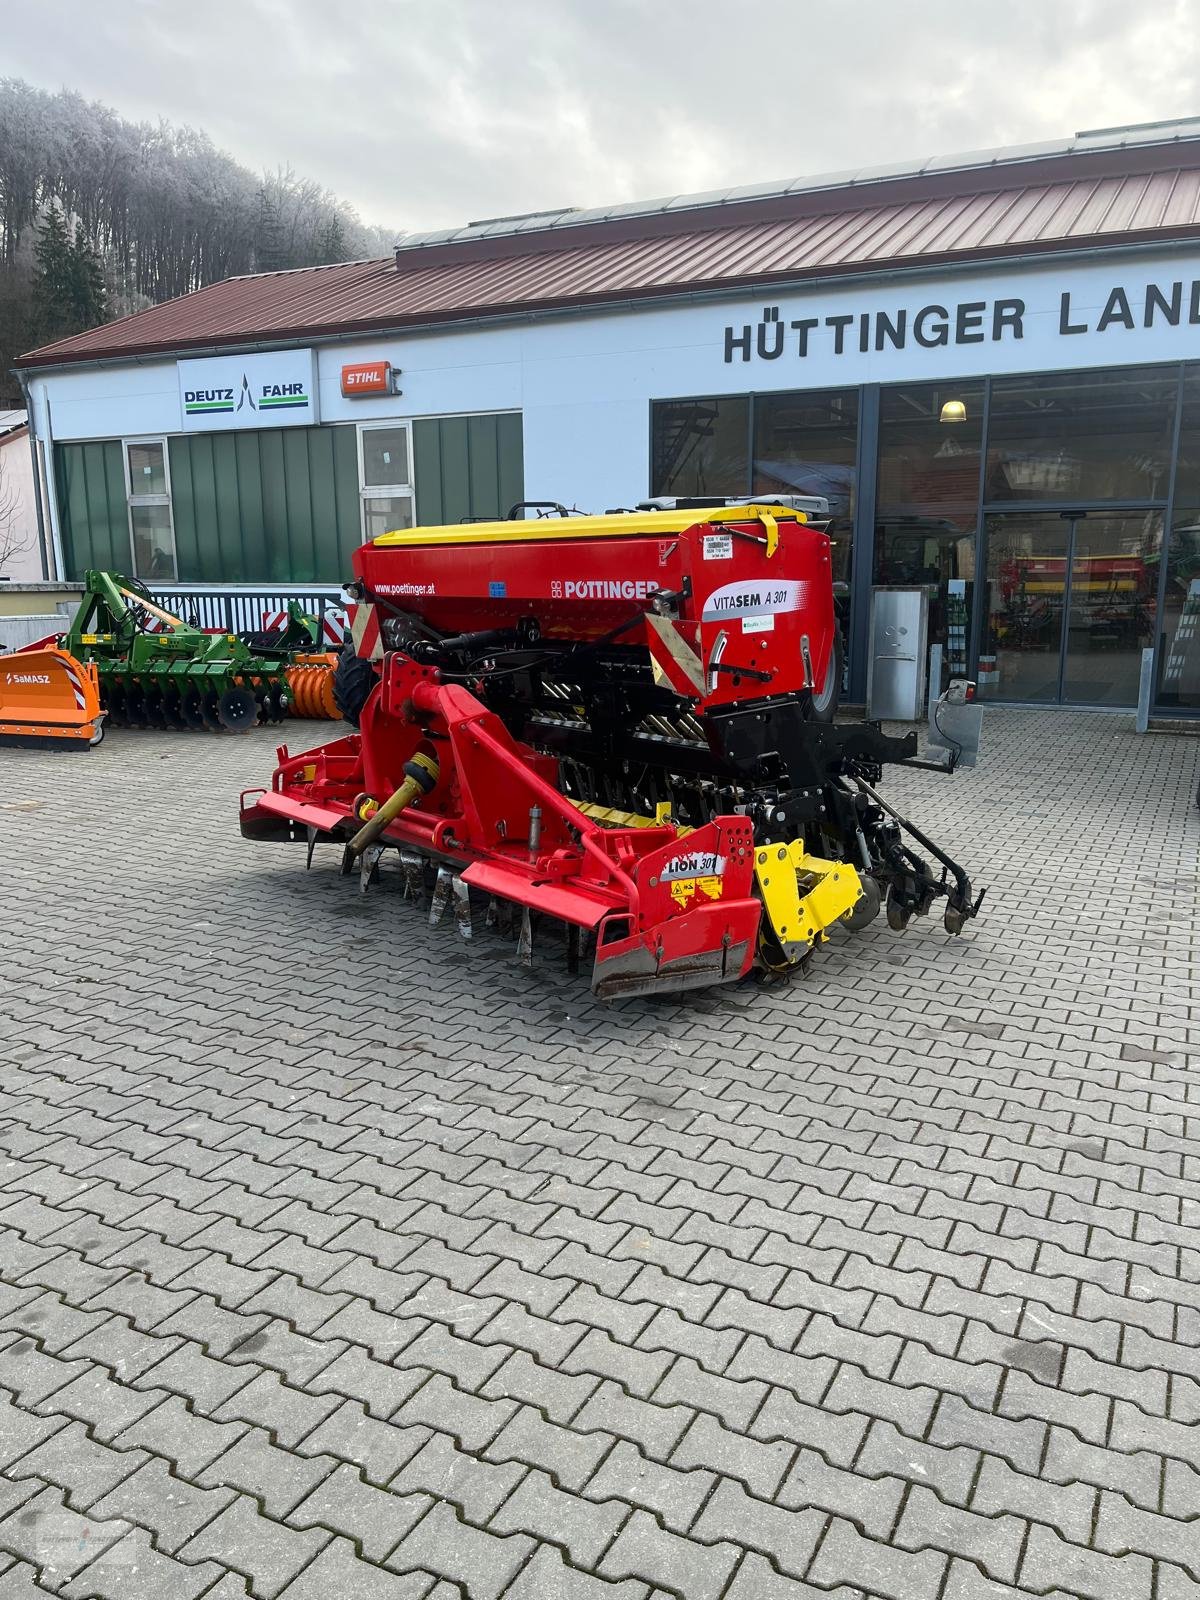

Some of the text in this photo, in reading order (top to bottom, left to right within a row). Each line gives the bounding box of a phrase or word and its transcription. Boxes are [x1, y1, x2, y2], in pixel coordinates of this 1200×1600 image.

[724, 298, 1025, 363] HÜTTINGER
[346, 370, 381, 385] STIHL
[184, 383, 304, 403] DEUTZ FAHR
[374, 583, 436, 596] www.poettinger.at
[713, 590, 788, 610] VITASEM A 301
[13, 674, 50, 684] SaMASZ
[668, 857, 716, 873] LION 301
